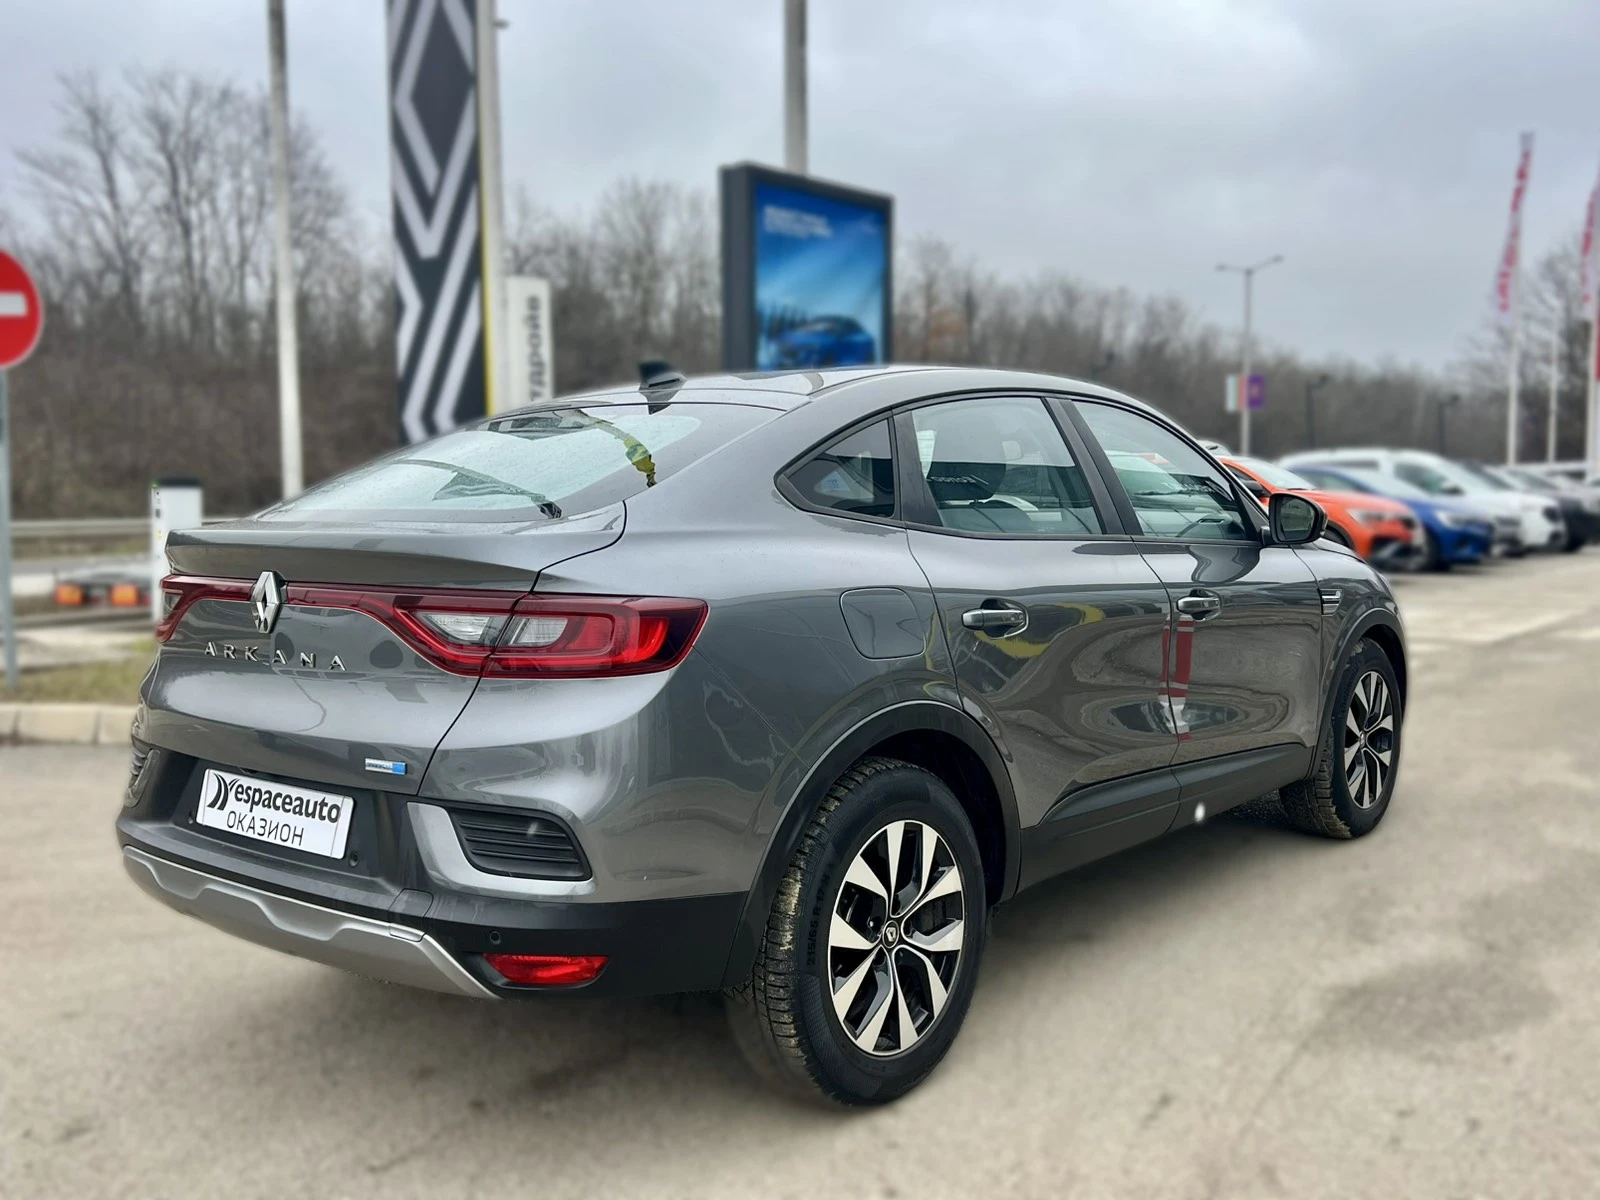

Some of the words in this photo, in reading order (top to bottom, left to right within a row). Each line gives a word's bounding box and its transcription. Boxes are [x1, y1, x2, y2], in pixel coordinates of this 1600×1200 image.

[204, 641, 348, 672] ARKANA
[234, 783, 341, 824] espaceauto
[226, 810, 304, 846] ОКАЗИОН
[807, 919, 819, 966] 215/65
